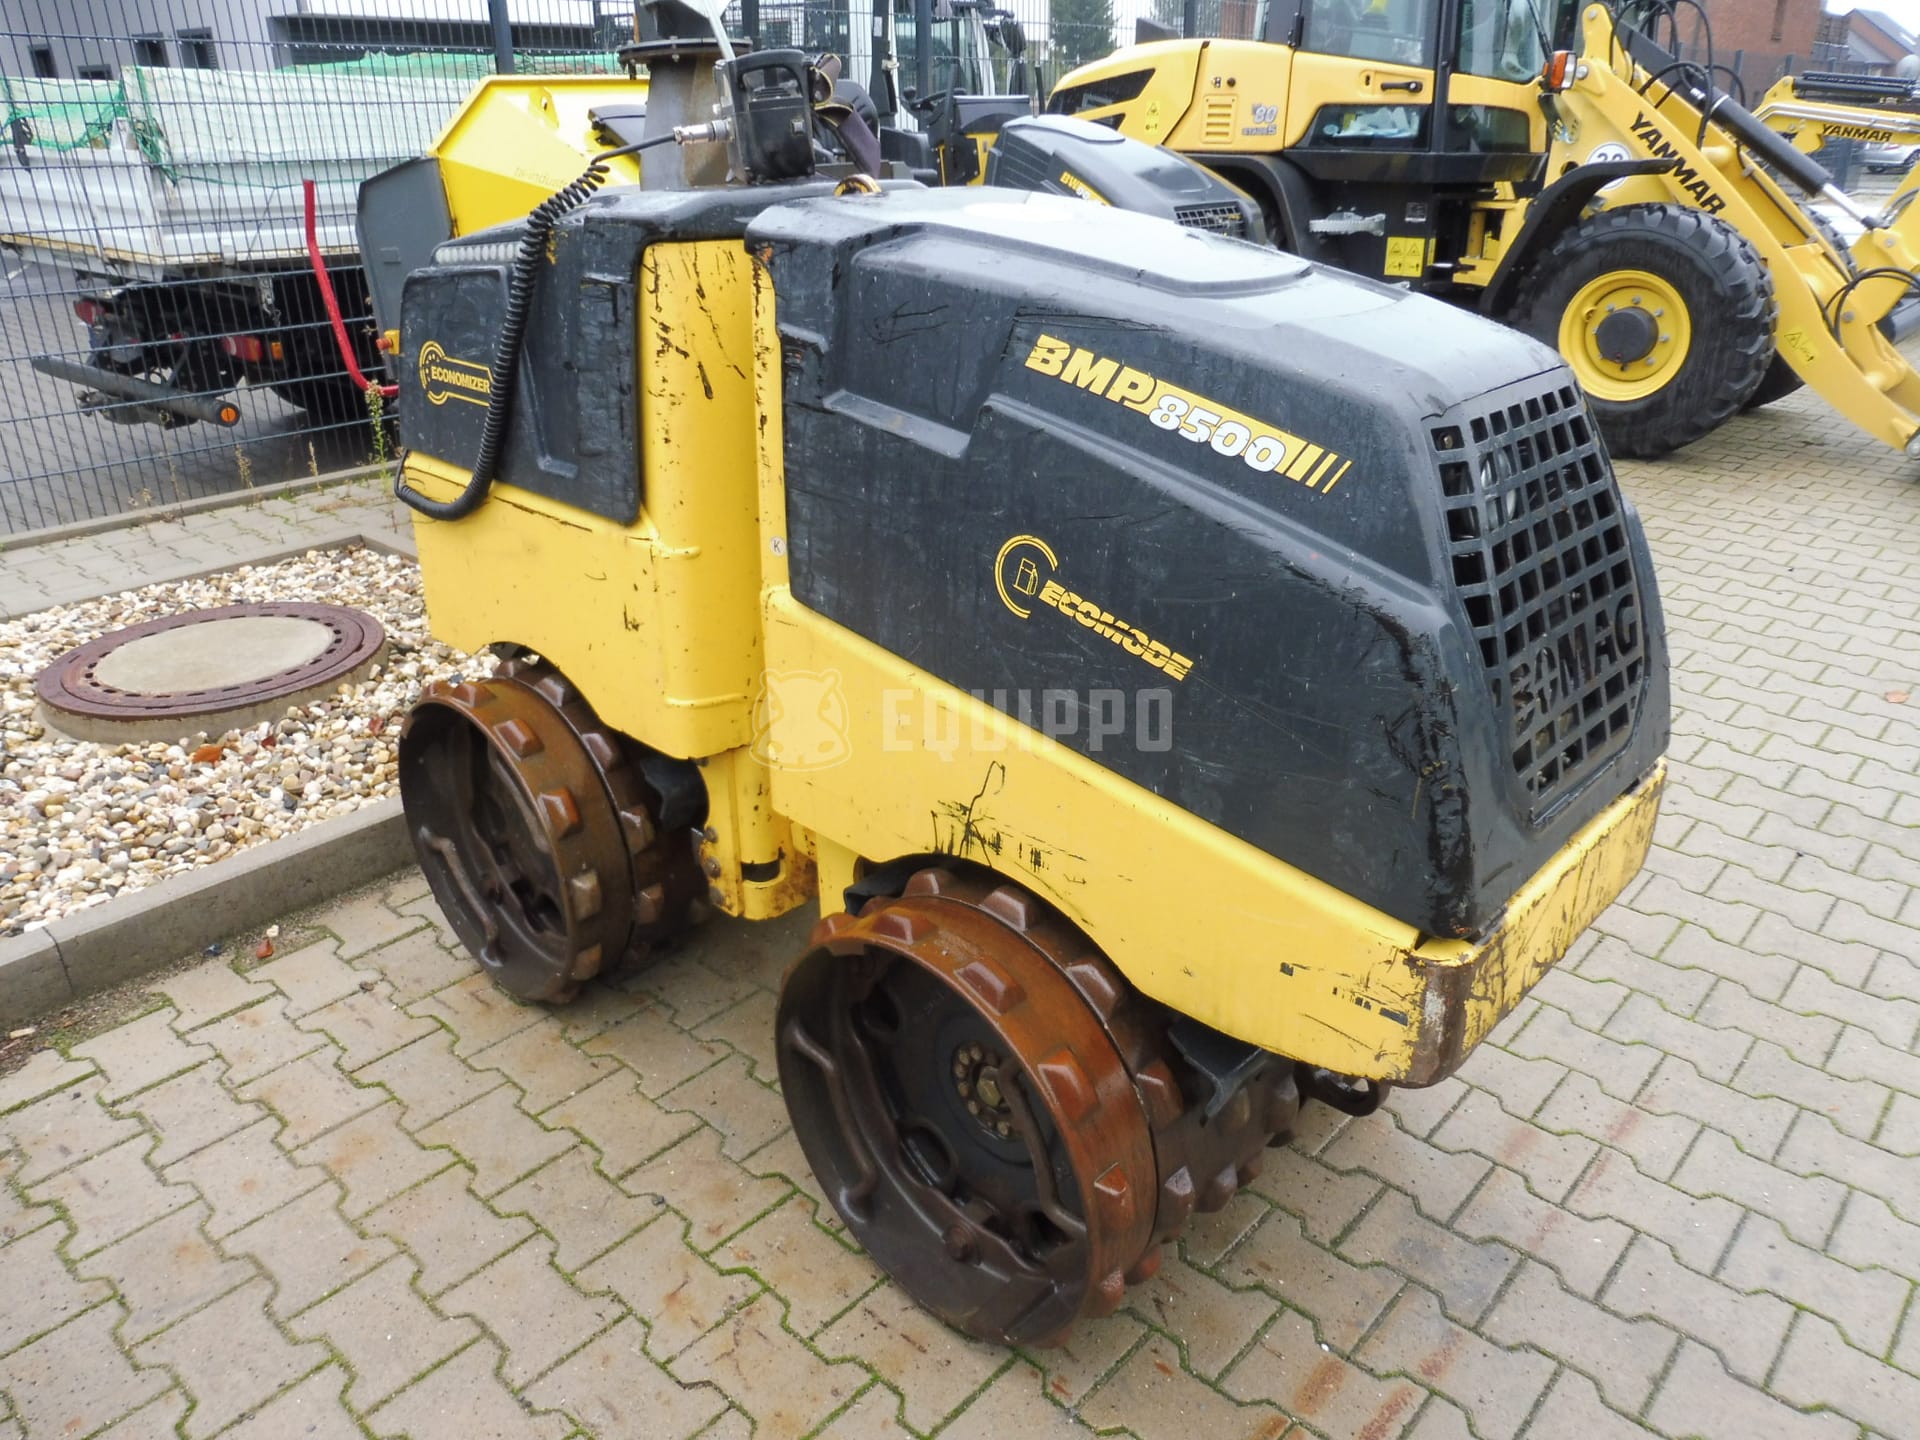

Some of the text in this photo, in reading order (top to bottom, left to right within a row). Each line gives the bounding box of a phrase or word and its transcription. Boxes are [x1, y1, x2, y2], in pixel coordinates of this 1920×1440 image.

[1630, 111, 1726, 215] YANMAR
[1822, 124, 1893, 142] YANMAR
[431, 365, 491, 395] ECONOMIZER
[1038, 579, 1194, 682] ECOMODE
